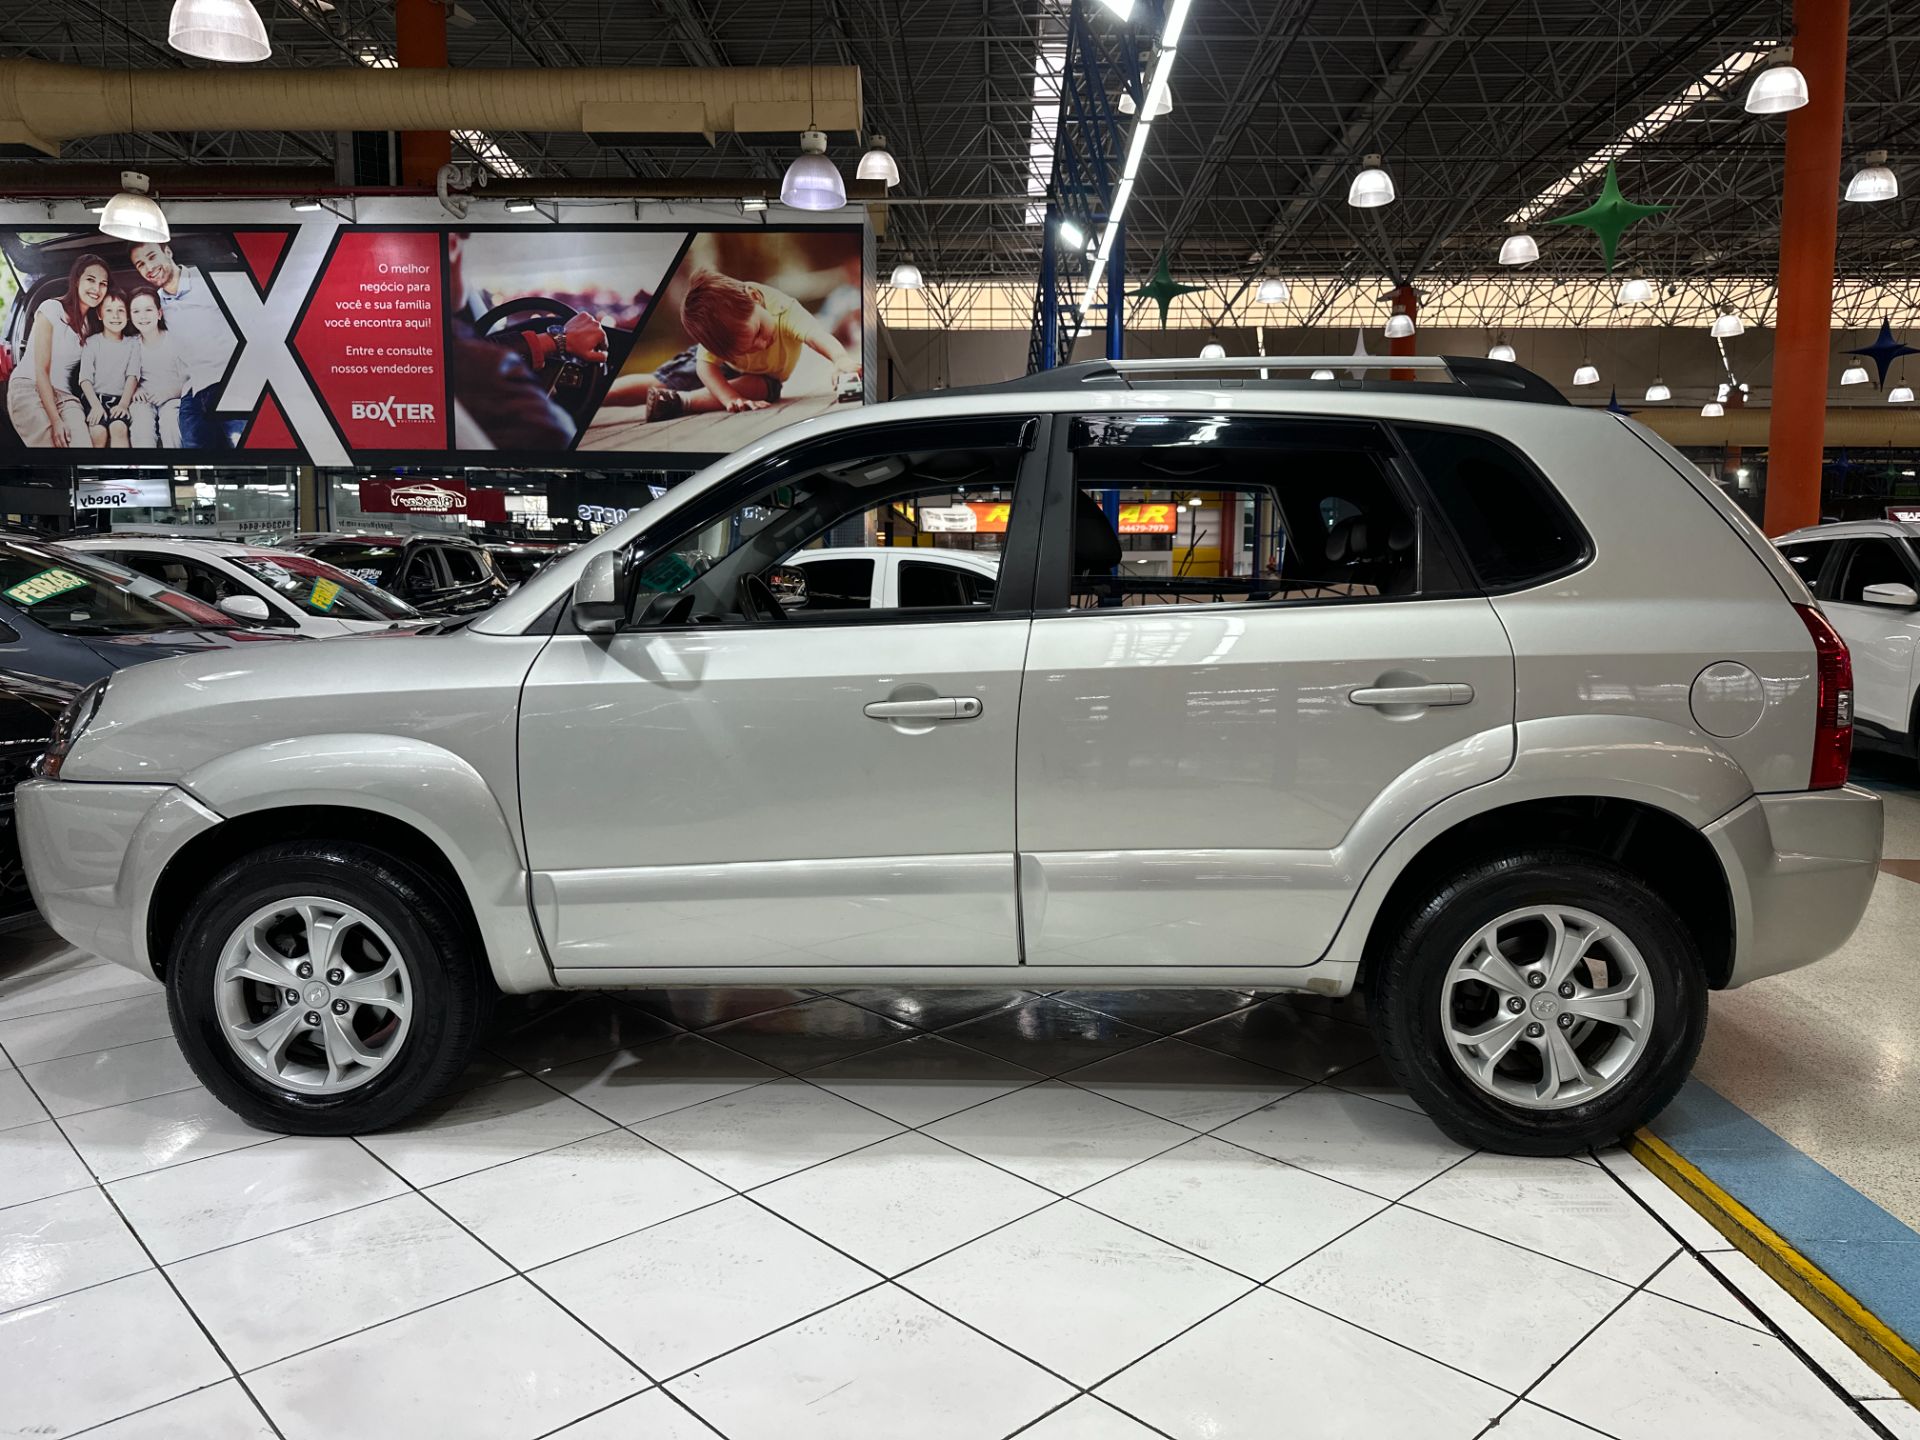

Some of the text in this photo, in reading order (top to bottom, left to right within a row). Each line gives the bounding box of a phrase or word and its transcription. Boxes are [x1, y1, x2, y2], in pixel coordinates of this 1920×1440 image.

[378, 264, 430, 274] O melhor
[360, 282, 431, 294] negócio para
[336, 299, 431, 310] você e sua família
[325, 318, 431, 330] você encontra aqui!
[346, 346, 374, 356] Entre
[386, 346, 433, 356] consulte
[331, 364, 434, 374] nossos vendedores
[352, 395, 436, 427] BOXTER
